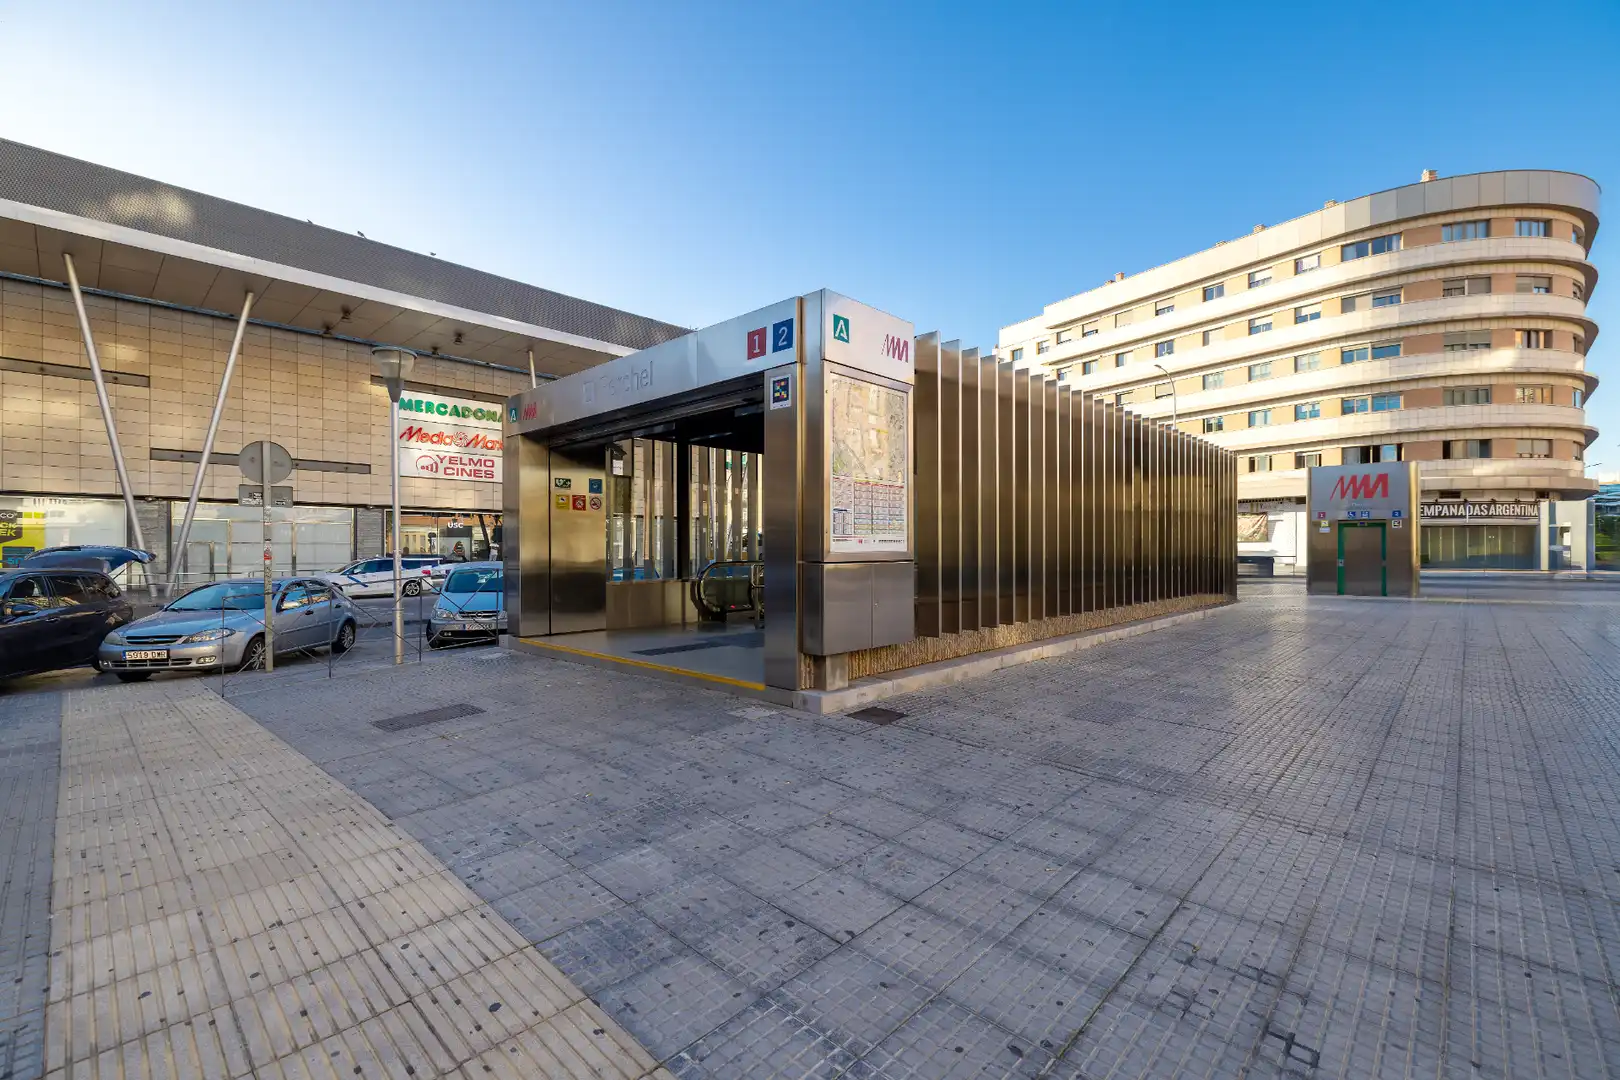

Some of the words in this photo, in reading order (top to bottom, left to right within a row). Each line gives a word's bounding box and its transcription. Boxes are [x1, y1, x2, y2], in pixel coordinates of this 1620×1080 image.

[752, 334, 760, 354] 1
[778, 326, 788, 347] 2
[436, 454, 495, 468] YELMO
[443, 467, 495, 479] CINES
[1420, 504, 1488, 517] EMPANADAS
